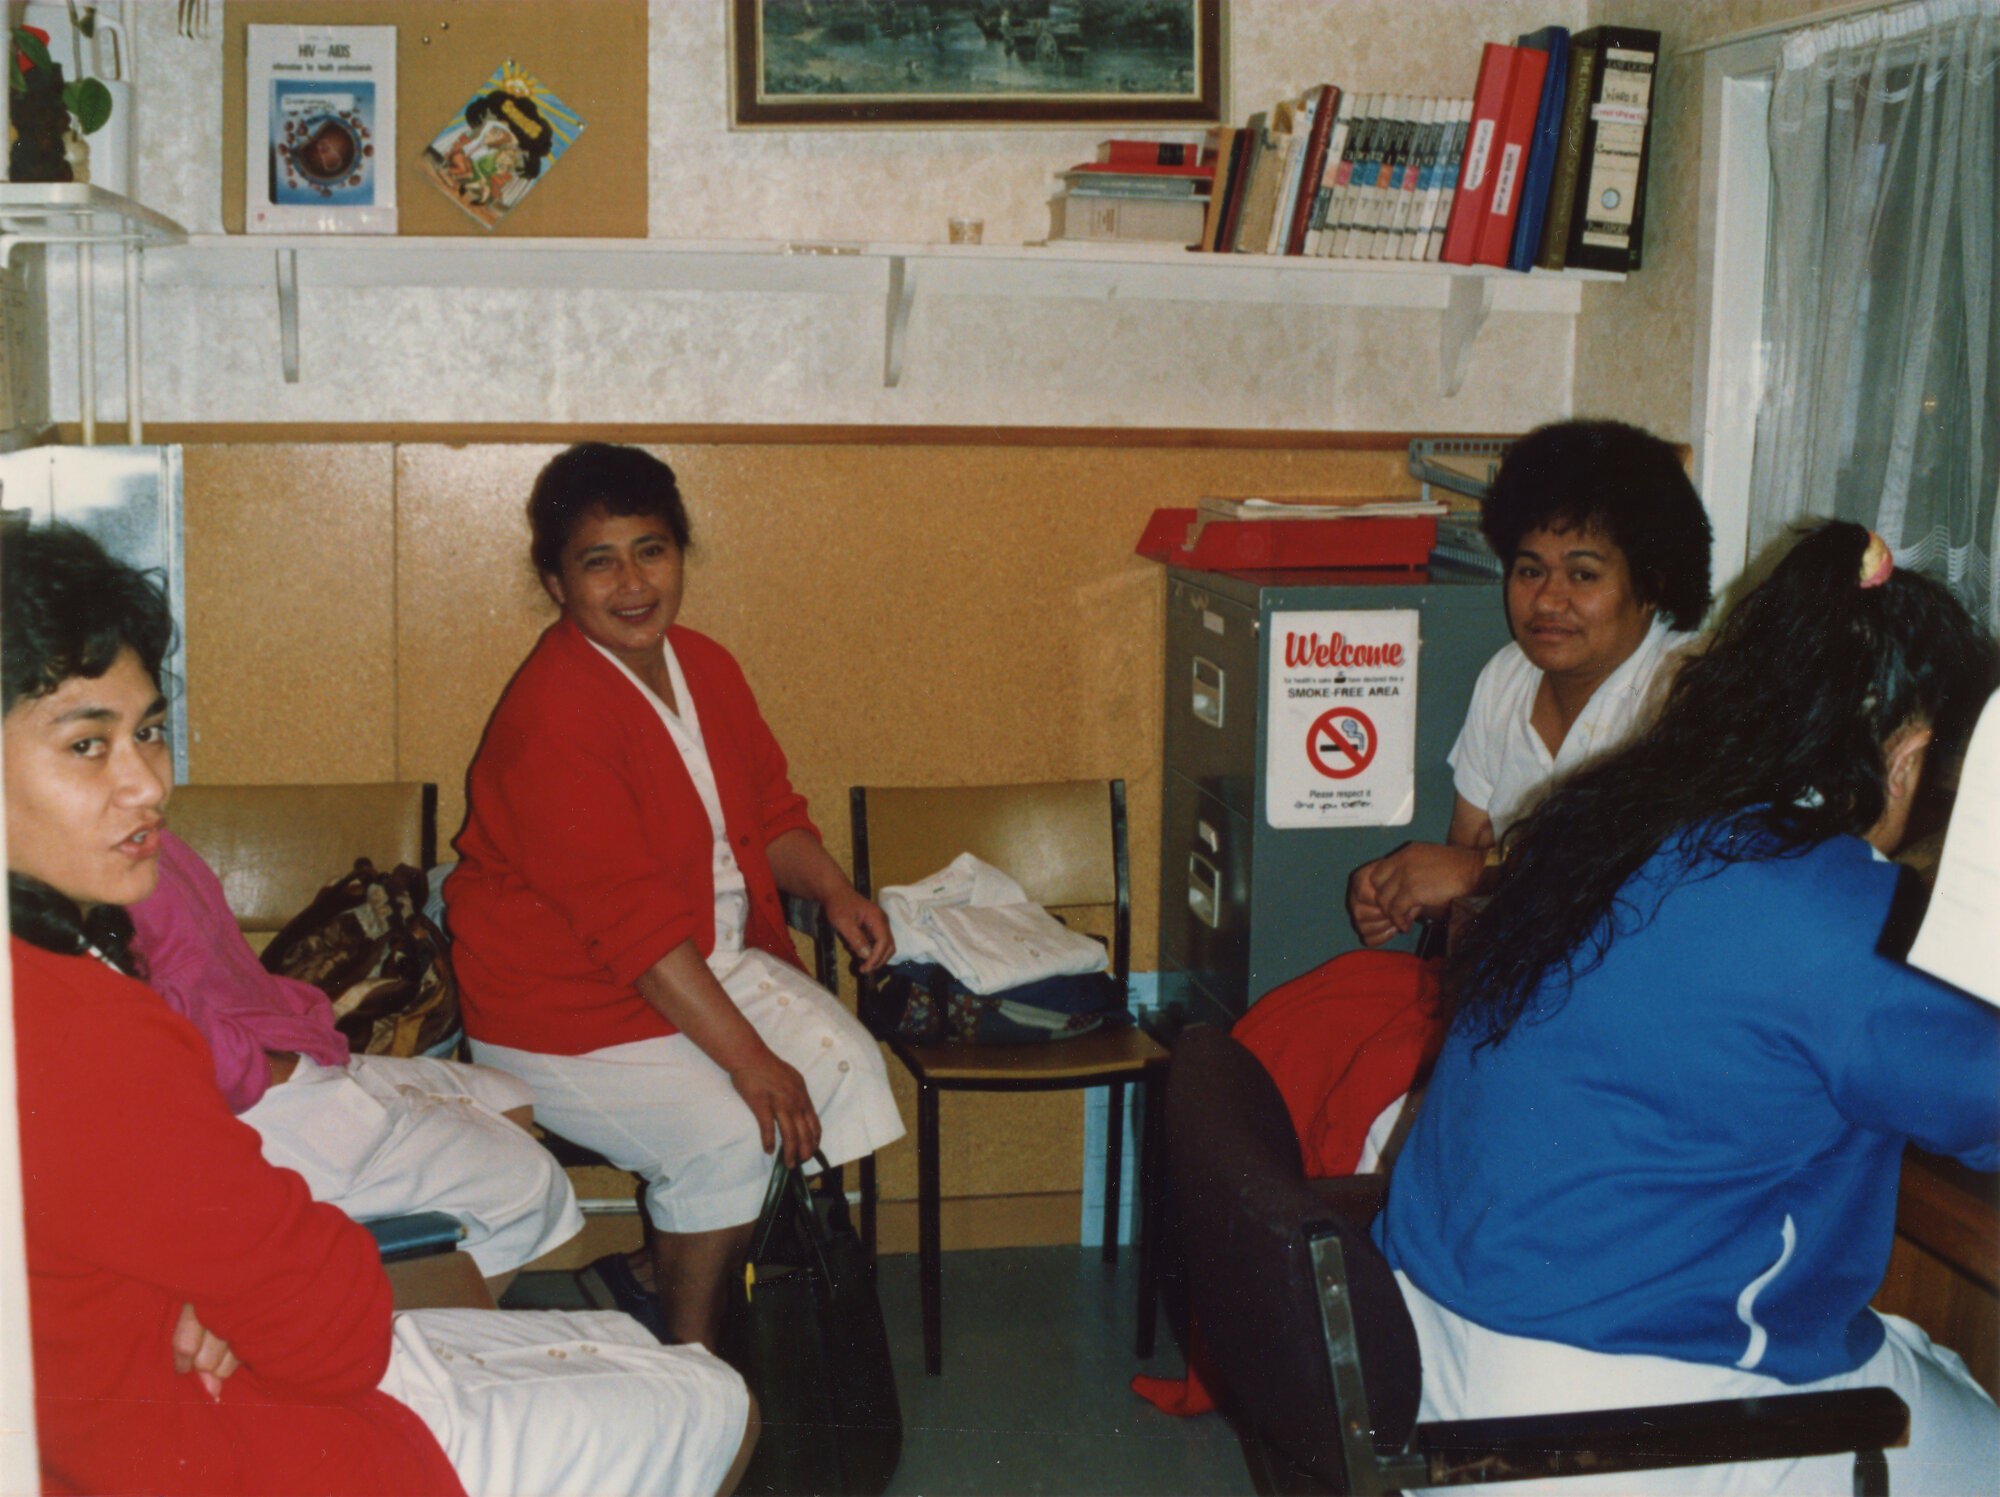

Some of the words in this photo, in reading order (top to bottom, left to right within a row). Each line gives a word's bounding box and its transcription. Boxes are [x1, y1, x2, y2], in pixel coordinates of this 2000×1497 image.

[298, 44, 316, 57] HIV
[328, 44, 351, 58] AIDS
[1284, 631, 1404, 668] Welcome
[1368, 687, 1400, 697] AREA
[1309, 790, 1333, 798] Please
[1336, 790, 1363, 799] respect
